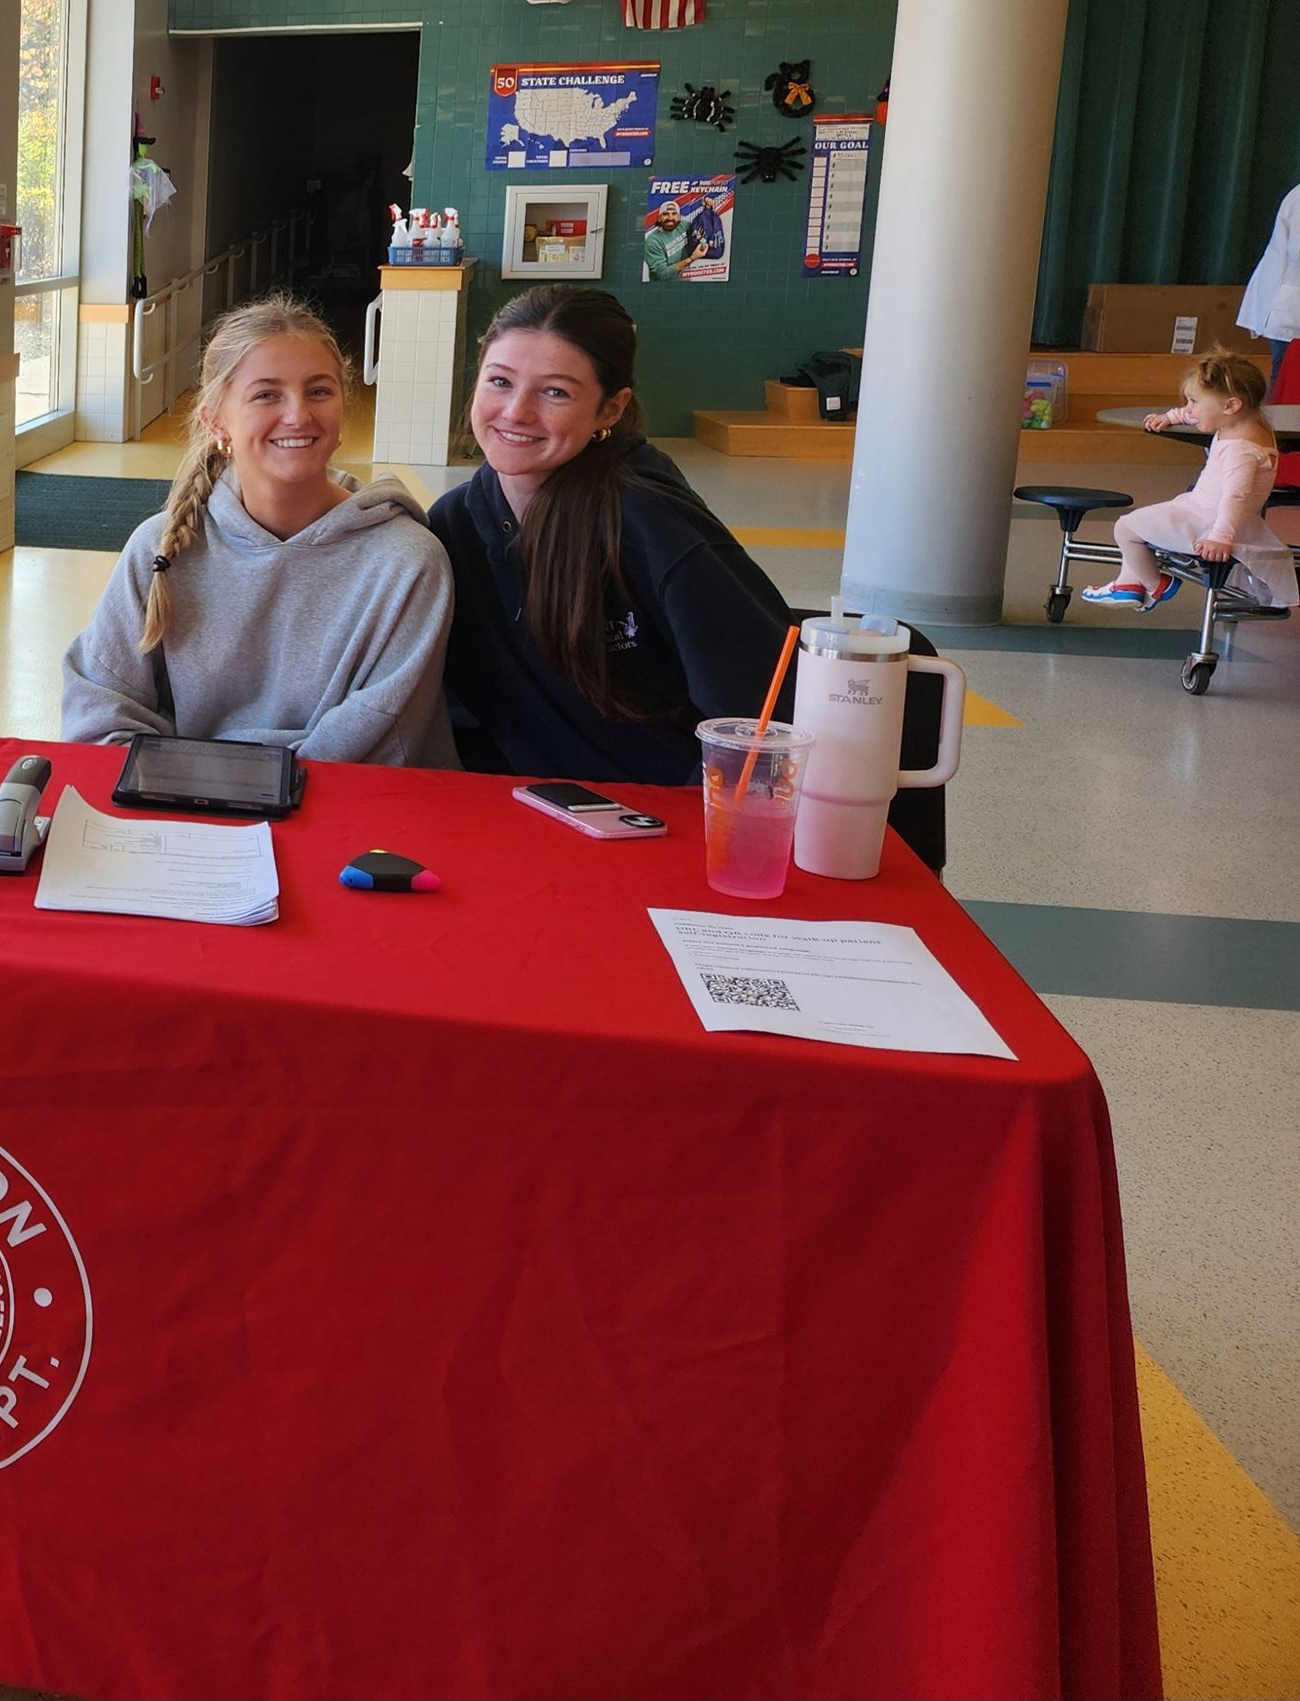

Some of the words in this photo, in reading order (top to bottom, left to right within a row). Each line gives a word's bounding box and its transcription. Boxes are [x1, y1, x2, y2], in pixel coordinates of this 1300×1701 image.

[497, 77, 515, 89] 50
[521, 76, 556, 87] STATE
[558, 75, 625, 86] CHALLENGE
[814, 142, 837, 150] OUR
[840, 141, 869, 150] GOAL
[651, 180, 690, 194] FREE
[828, 693, 883, 705] STANLEY
